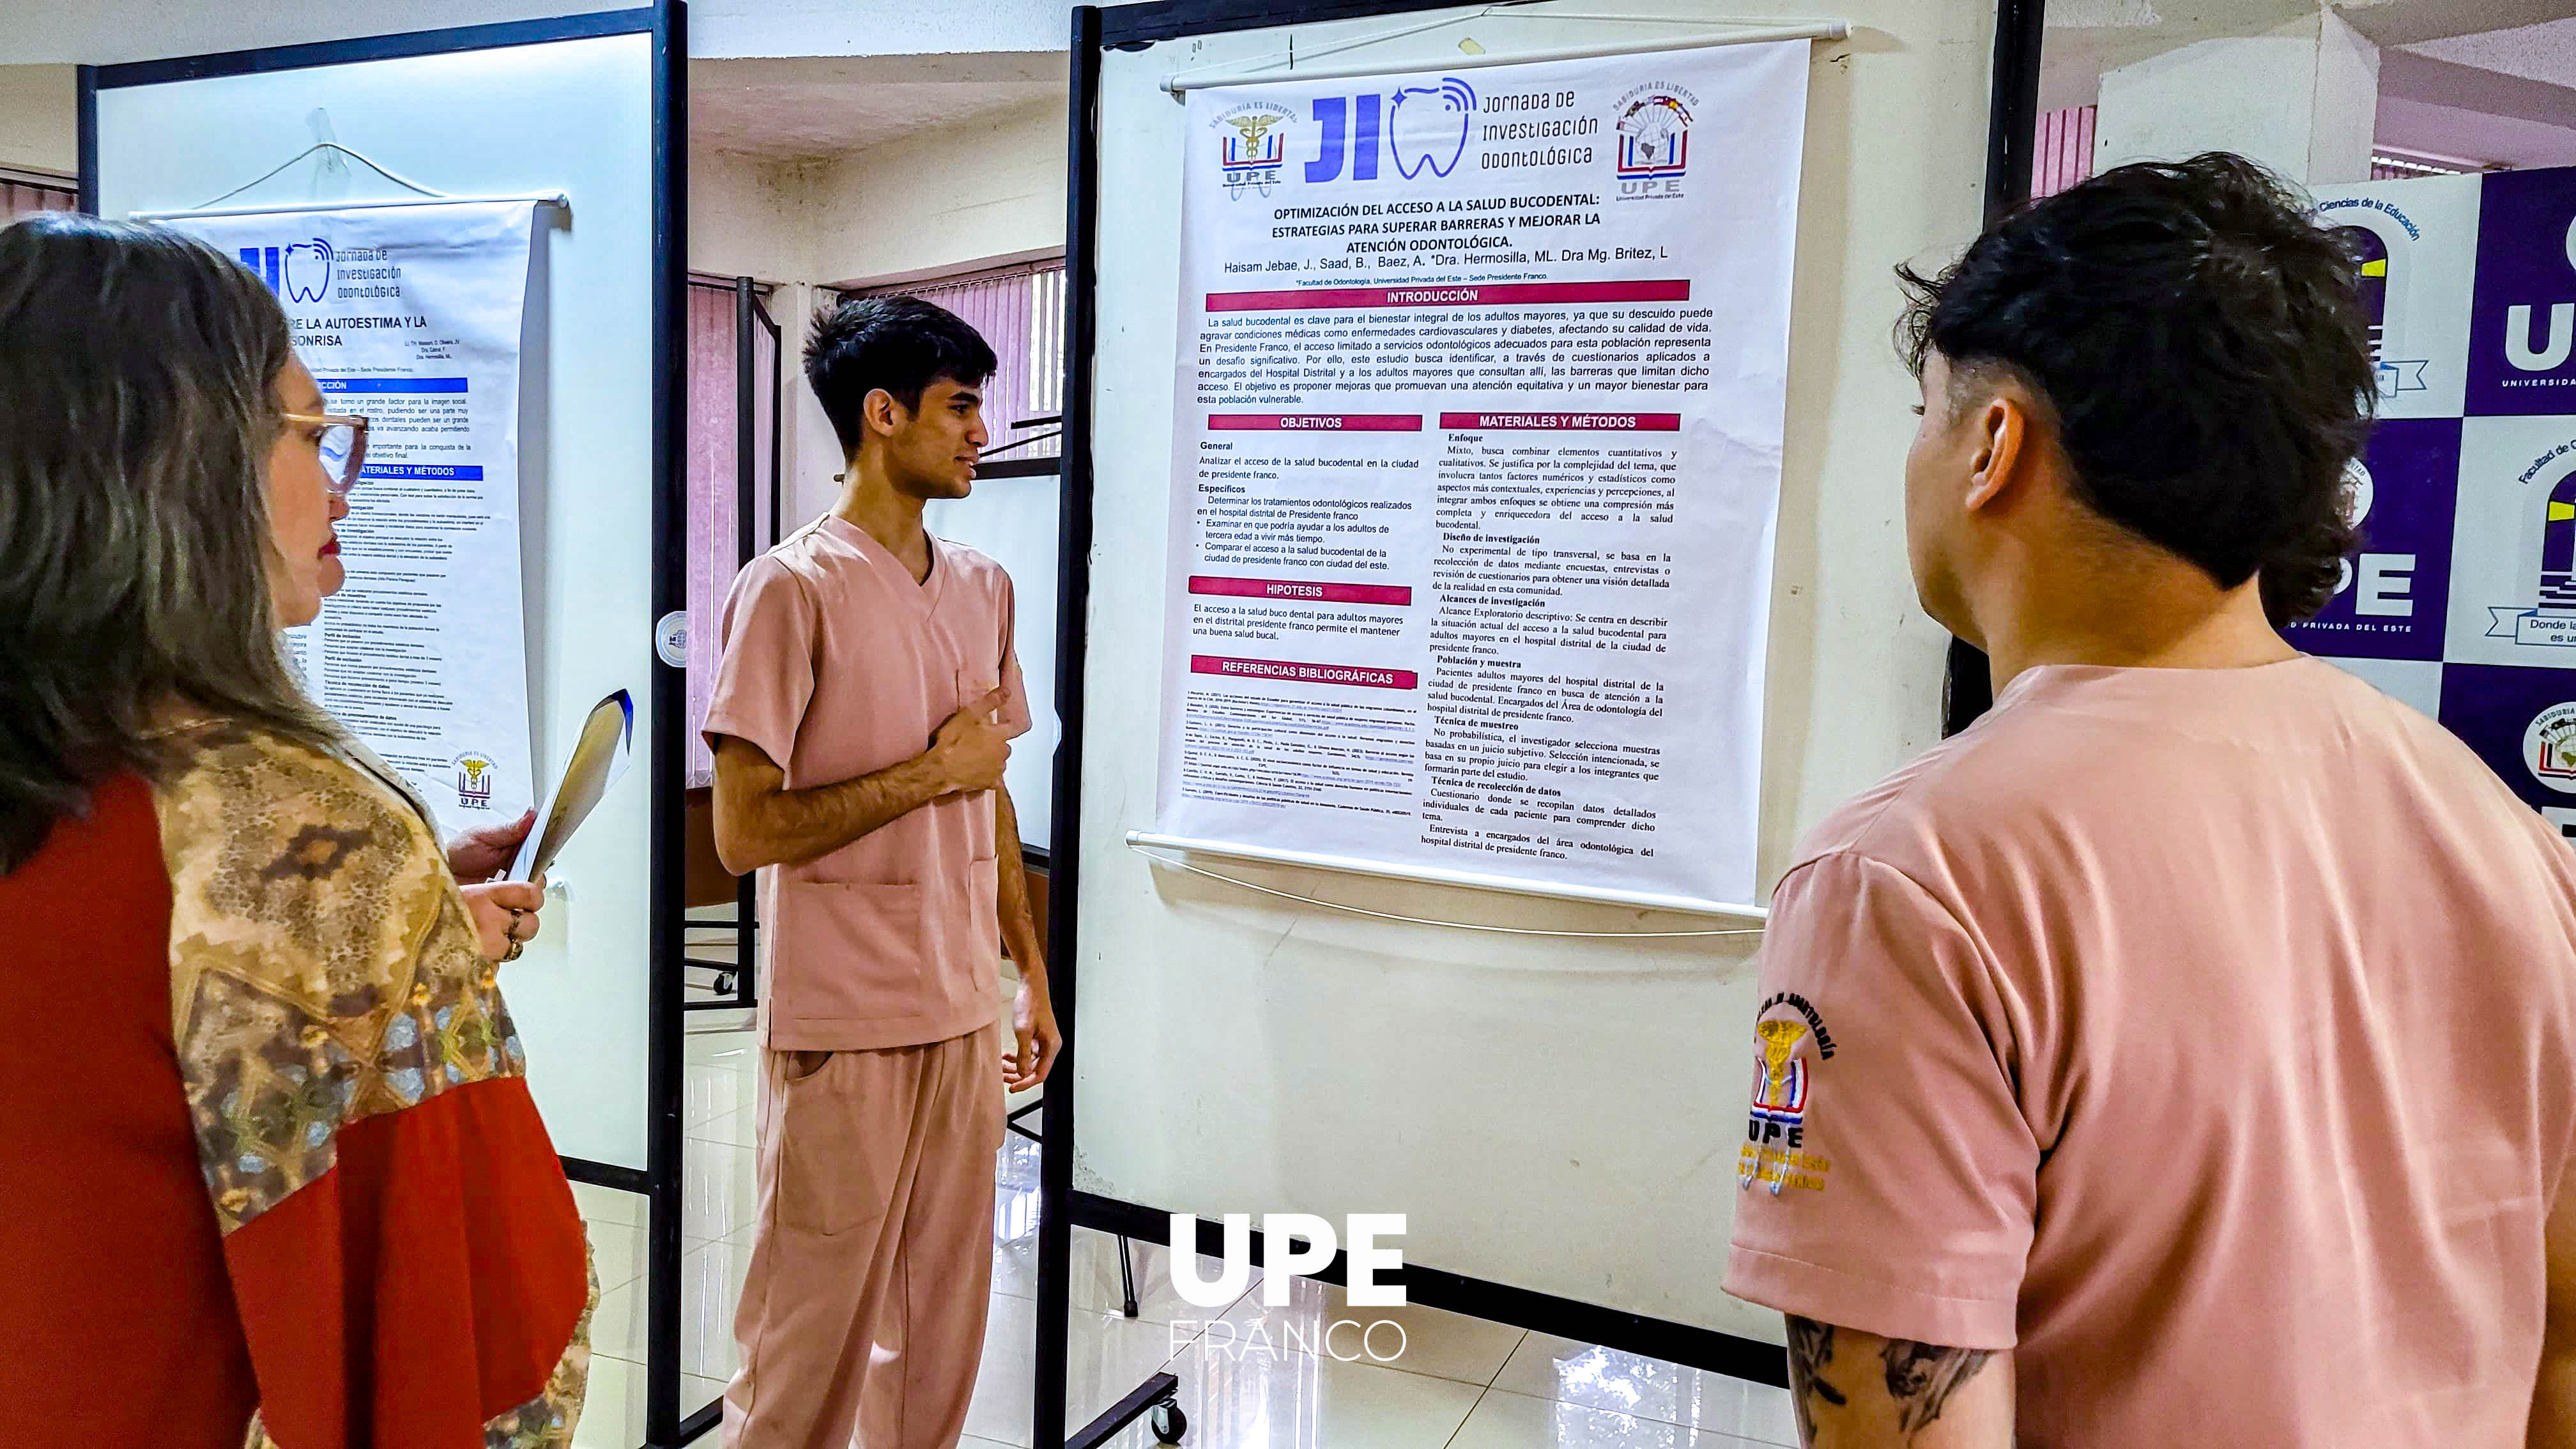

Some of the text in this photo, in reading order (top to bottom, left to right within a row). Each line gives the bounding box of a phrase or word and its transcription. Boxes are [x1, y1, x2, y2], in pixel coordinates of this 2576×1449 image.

[1227, 171, 1276, 183] UPE
[1621, 180, 1680, 194] UPE
[1274, 194, 1599, 219] OPTIMIZACIÓN DEL ACCESO A LA SALUD BUCODENTAL:
[2319, 197, 2420, 241] Ciencias de la Educación
[1273, 213, 1600, 238] ESTRATEGIAS PARA SUPERAR BARRERAS Y MEJORAR LA
[1346, 234, 1512, 253] ATENCIÓN ODONTOLÓGICA.
[1225, 262, 1262, 273] Haisam
[1561, 249, 1583, 261] Dra
[1660, 246, 1667, 257] L
[1386, 288, 1477, 302] INTRODUCCIÓN
[306, 318, 322, 329] LA
[325, 317, 402, 329] AUTOESTIMA
[404, 316, 411, 328] Y
[414, 316, 427, 327] LA
[1208, 318, 1218, 326] La
[1222, 318, 1242, 326] salud
[1246, 316, 1291, 326] bucodental
[1308, 316, 1330, 324] clave
[1333, 316, 1353, 325] para
[1357, 314, 1365, 323] el
[1368, 314, 1410, 323] bienestar
[1414, 312, 1448, 324] integral
[1452, 312, 1464, 321] de
[1468, 312, 1480, 321] los
[1485, 311, 1519, 321] adultos
[1524, 312, 1568, 322] mayores,
[1573, 312, 1584, 322] ya
[1589, 312, 1607, 321] que
[1629, 308, 1675, 318] descuido
[1680, 307, 1712, 320] puede
[2502, 379, 2576, 387] UNIVERSIDA
[1280, 418, 1341, 427] OBJETIVOS
[1480, 415, 1636, 427] MATERIALES Y MÉTODOS
[1448, 433, 1483, 444] Enfoque
[1200, 441, 1232, 450] General
[1199, 456, 1231, 464] Analizar
[1234, 457, 1241, 465] el
[1294, 457, 1315, 466] salud
[1318, 457, 1363, 467] bucodental
[1381, 459, 1388, 467] la
[1392, 459, 1418, 468] ciudad
[2518, 445, 2569, 484] Facultad de
[360, 466, 404, 475] ATERIALES
[1199, 484, 1245, 494] Específicos
[1443, 532, 1539, 544] Diseño de investigación
[1267, 584, 1322, 596] HIPOTESIS
[1194, 604, 1201, 612] El
[1248, 608, 1267, 616] salud
[1269, 608, 1287, 617] buco
[1289, 610, 1314, 618] dental
[1317, 613, 1334, 621] para
[1337, 613, 1366, 622] adultos
[1368, 616, 1403, 625] mayores
[2303, 622, 2349, 631] PRIVADA
[2530, 620, 2566, 629] Donde
[1438, 655, 1477, 665] Población
[1223, 661, 1393, 684] REFERENCIAS BIBLIOGRÁFICAS
[1431, 776, 1561, 796] Técnica de recolección de datos
[461, 797, 487, 807] UPE
[1748, 1120, 1803, 1148] UPE
